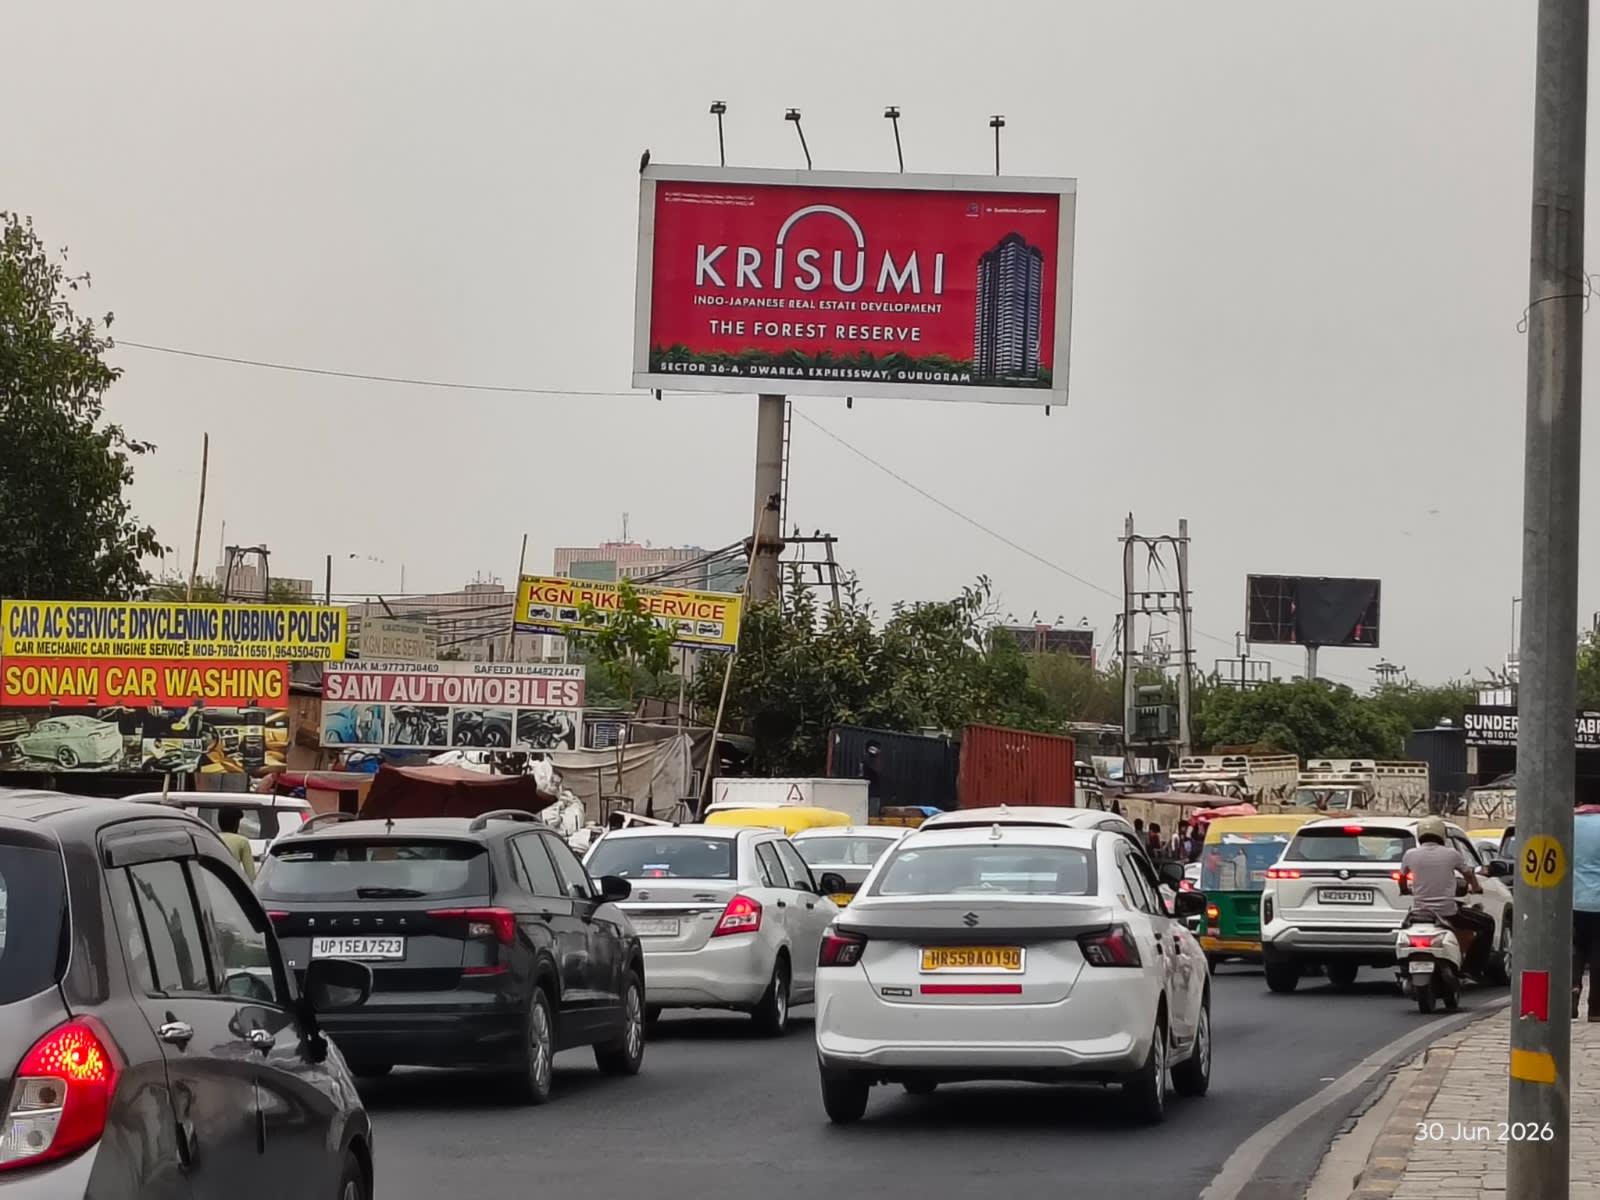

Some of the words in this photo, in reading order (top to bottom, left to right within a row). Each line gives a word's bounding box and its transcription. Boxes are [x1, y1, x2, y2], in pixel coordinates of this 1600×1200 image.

[695, 244, 944, 295] KRISUMI
[693, 295, 785, 309] INDO-JAPANESE
[788, 299, 816, 309] REAL
[819, 300, 857, 311] ESTATE
[861, 302, 942, 313] DEVELOPMENT
[709, 319, 745, 335] THE
[754, 322, 827, 339] FOREST
[836, 325, 921, 341] RESERVE
[660, 361, 705, 372] SECTOR
[710, 364, 744, 375] 36-A,
[750, 366, 804, 376] DWARKA
[808, 367, 891, 380] EXPRESSWAY,
[897, 370, 970, 382] GURUGRAM
[529, 585, 574, 605] KGN
[637, 596, 726, 620] SERVICE
[9, 605, 40, 638] CAR
[42, 606, 63, 639] AC
[66, 606, 126, 639] SERVICE
[129, 607, 218, 641] DRYCLENING
[222, 608, 285, 643] RUBBING
[288, 610, 340, 643] POLISH
[14, 641, 34, 654] CAR
[36, 641, 88, 655] MECHANIC
[90, 642, 110, 655] CAR
[112, 642, 146, 656] INGINE
[149, 643, 190, 657] SERVICE
[474, 664, 513, 675] SAFEED
[5, 665, 99, 696] SONAM
[105, 666, 158, 697] CAR
[164, 668, 282, 698] WASHING
[326, 673, 383, 700] SAM
[390, 676, 579, 706] AUTOMOBILES
[1464, 714, 1519, 731] SUNDER
[1526, 839, 1557, 883] 9/6
[320, 940, 402, 953] UP15EA7523
